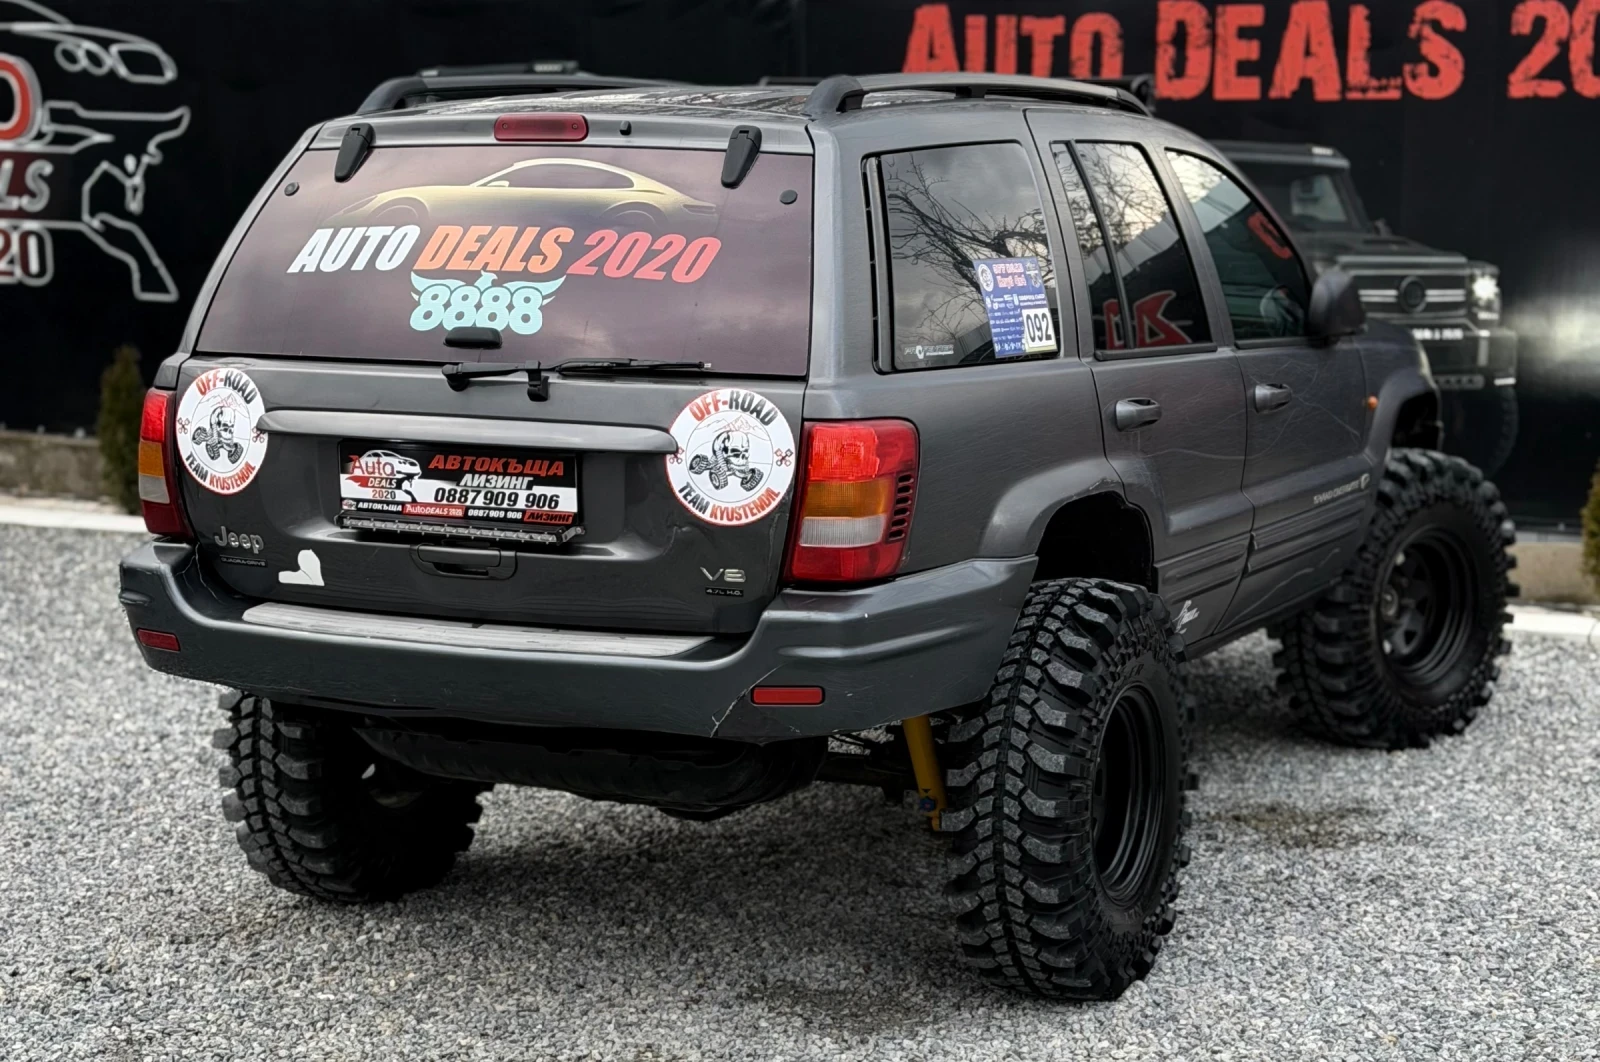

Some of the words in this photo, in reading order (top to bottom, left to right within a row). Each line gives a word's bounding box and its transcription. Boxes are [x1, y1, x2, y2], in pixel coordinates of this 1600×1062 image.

[902, 3, 1123, 79] AUTO
[1155, 0, 1466, 100] DEALS
[286, 225, 421, 274] AUTO
[412, 225, 575, 274] DEALS
[566, 229, 722, 284] 2020
[409, 282, 543, 335] 8888
[1026, 312, 1052, 343] 092
[196, 370, 257, 404] OFF-ROAD
[689, 390, 778, 426] OFF-ROAD
[185, 453, 209, 482] TEAM
[348, 455, 397, 477] Auto
[428, 455, 564, 476] АВТОКЪЩА
[368, 478, 397, 489] DEALS
[372, 489, 397, 500] 2020
[459, 473, 534, 490] ЛИЗИНГ
[357, 501, 402, 513] АВТОКЪЩА
[468, 509, 488, 518] 0887
[489, 510, 505, 519] 909
[506, 511, 523, 520] 906
[527, 511, 573, 523] ЛИЗИНГ
[434, 487, 483, 506] 0887
[482, 490, 520, 508] 909
[524, 493, 561, 510] 906
[678, 482, 710, 514] TEAM
[214, 525, 264, 554] Jeep
[700, 566, 747, 583] V8
